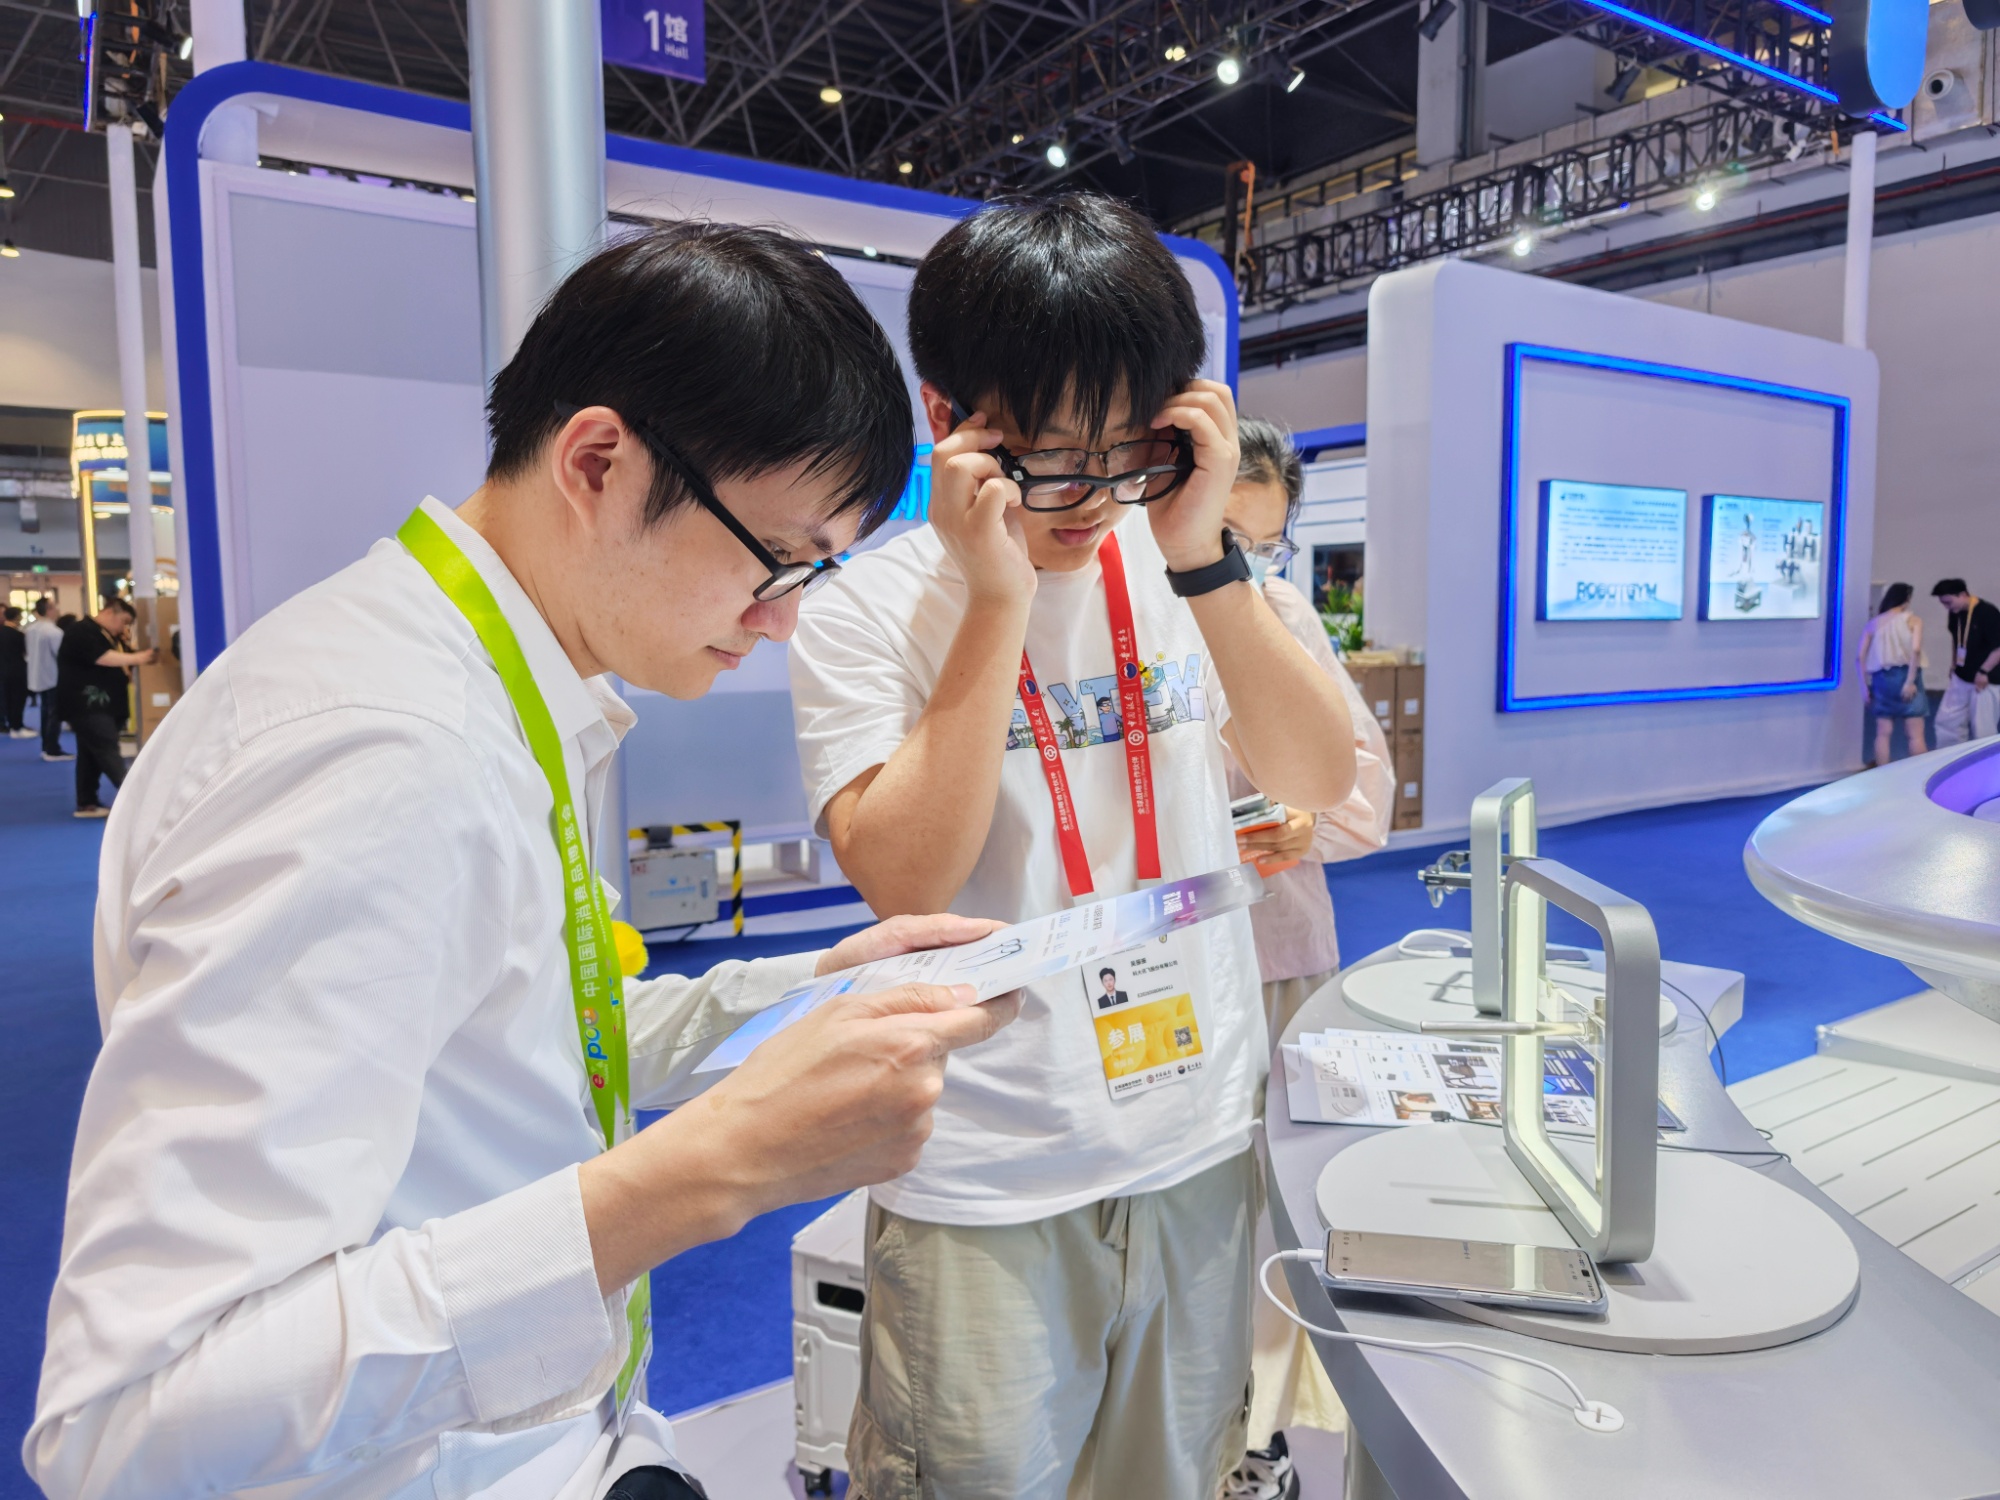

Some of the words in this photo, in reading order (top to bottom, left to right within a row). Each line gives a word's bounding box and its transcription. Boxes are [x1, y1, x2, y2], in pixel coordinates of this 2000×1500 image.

[664, 43, 689, 60] Hall
[1051, 772, 1070, 831] 全球战略合作伙伴
[1130, 756, 1145, 815] 全球战略合作伙伴
[562, 804, 600, 997] 中国国际消费品博览会
[1107, 1022, 1146, 1049] 参展
